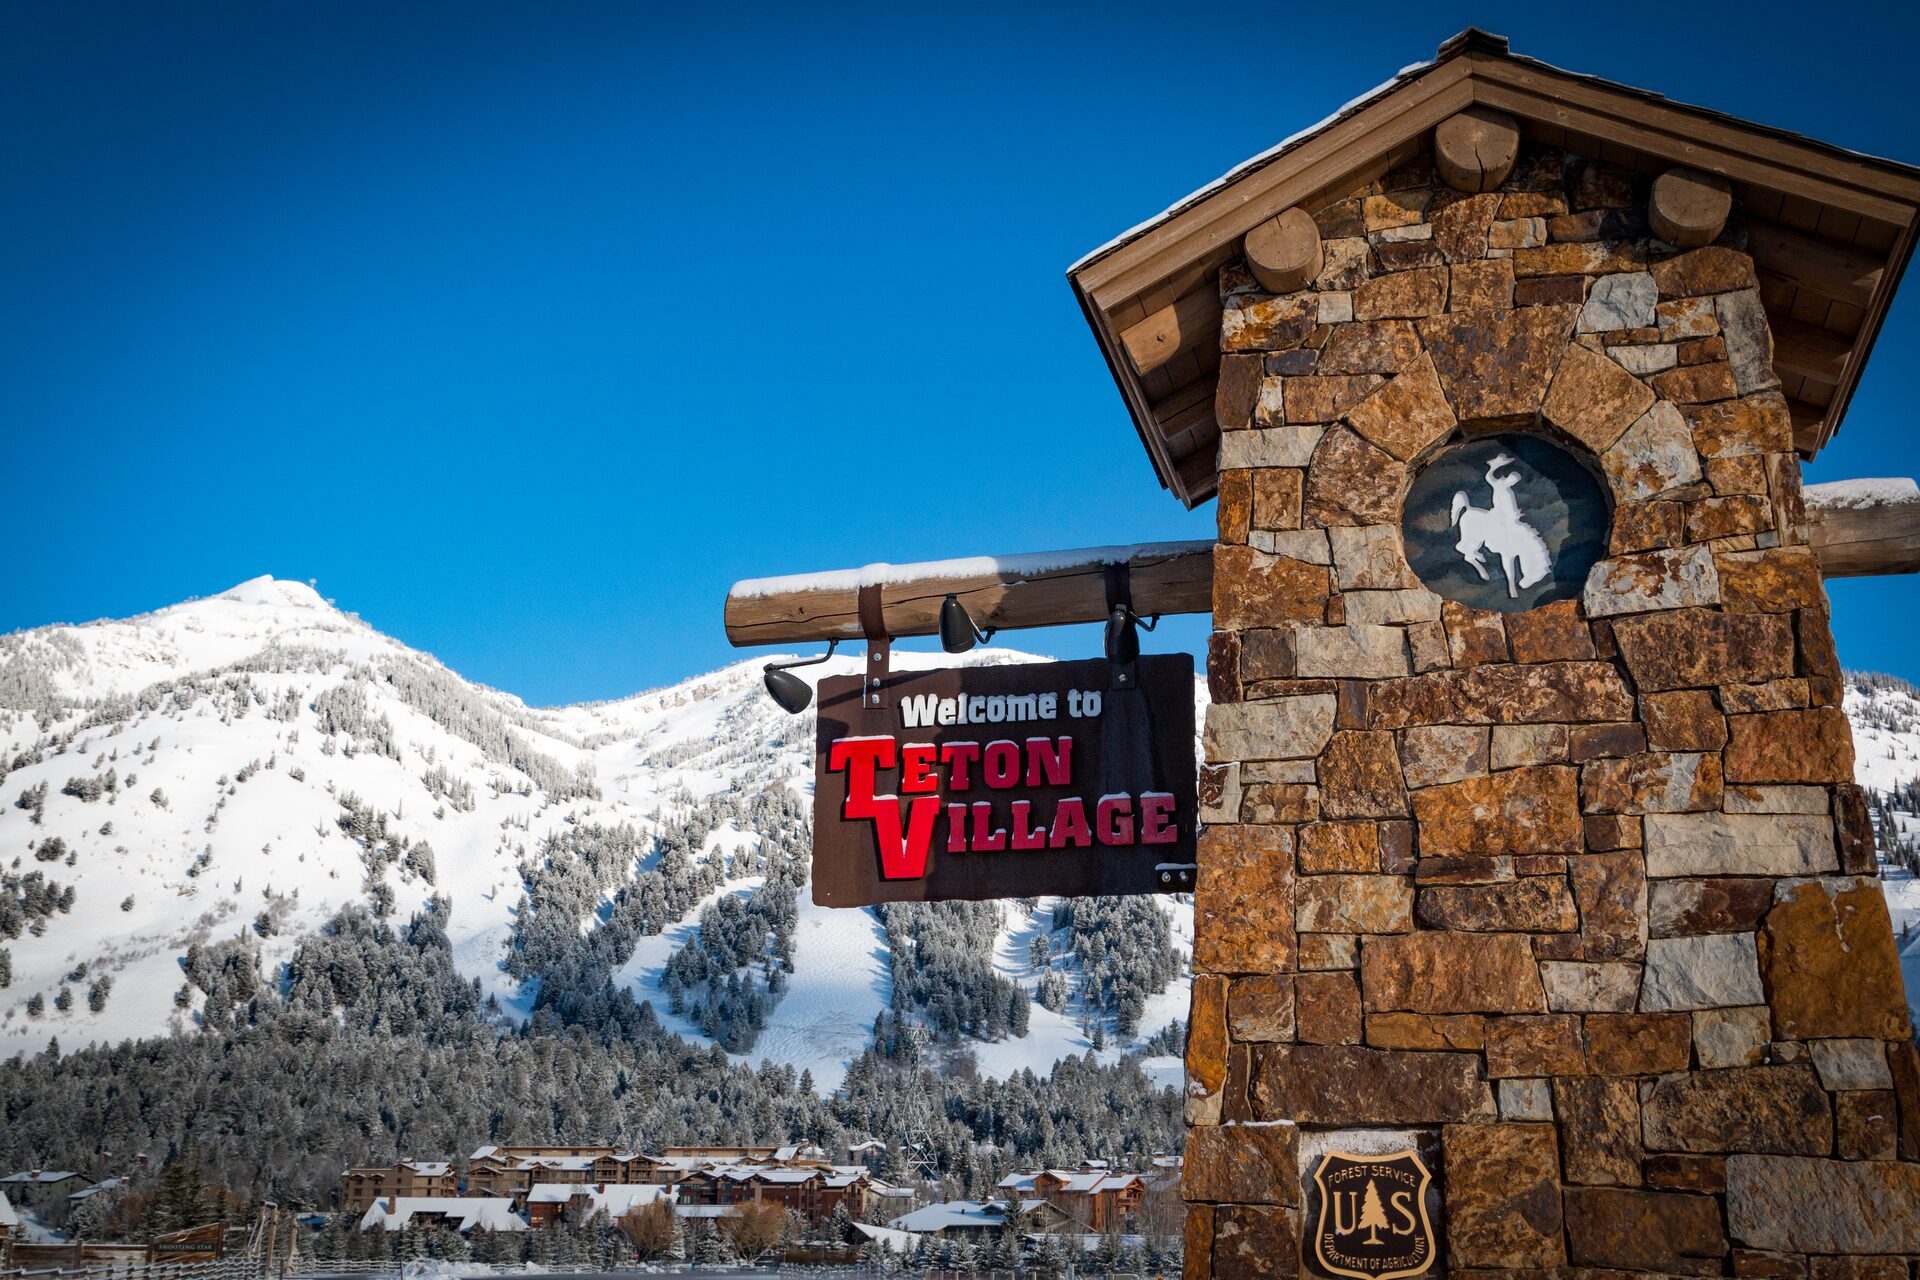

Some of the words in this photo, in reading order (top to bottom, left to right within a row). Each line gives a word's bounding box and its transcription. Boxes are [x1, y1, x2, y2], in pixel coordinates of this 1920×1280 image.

[901, 691, 1058, 728] Welcome
[1068, 689, 1102, 719] to
[829, 735, 1073, 819] TETON
[873, 791, 1178, 879] VILLAGE
[1328, 1165, 1368, 1188] FOREST
[1371, 1165, 1417, 1188] SERVICE
[1324, 1233, 1368, 1269] DEPARTMENT
[1369, 1258, 1381, 1269] OF
[1382, 1234, 1425, 1269] AGRICULTURE
